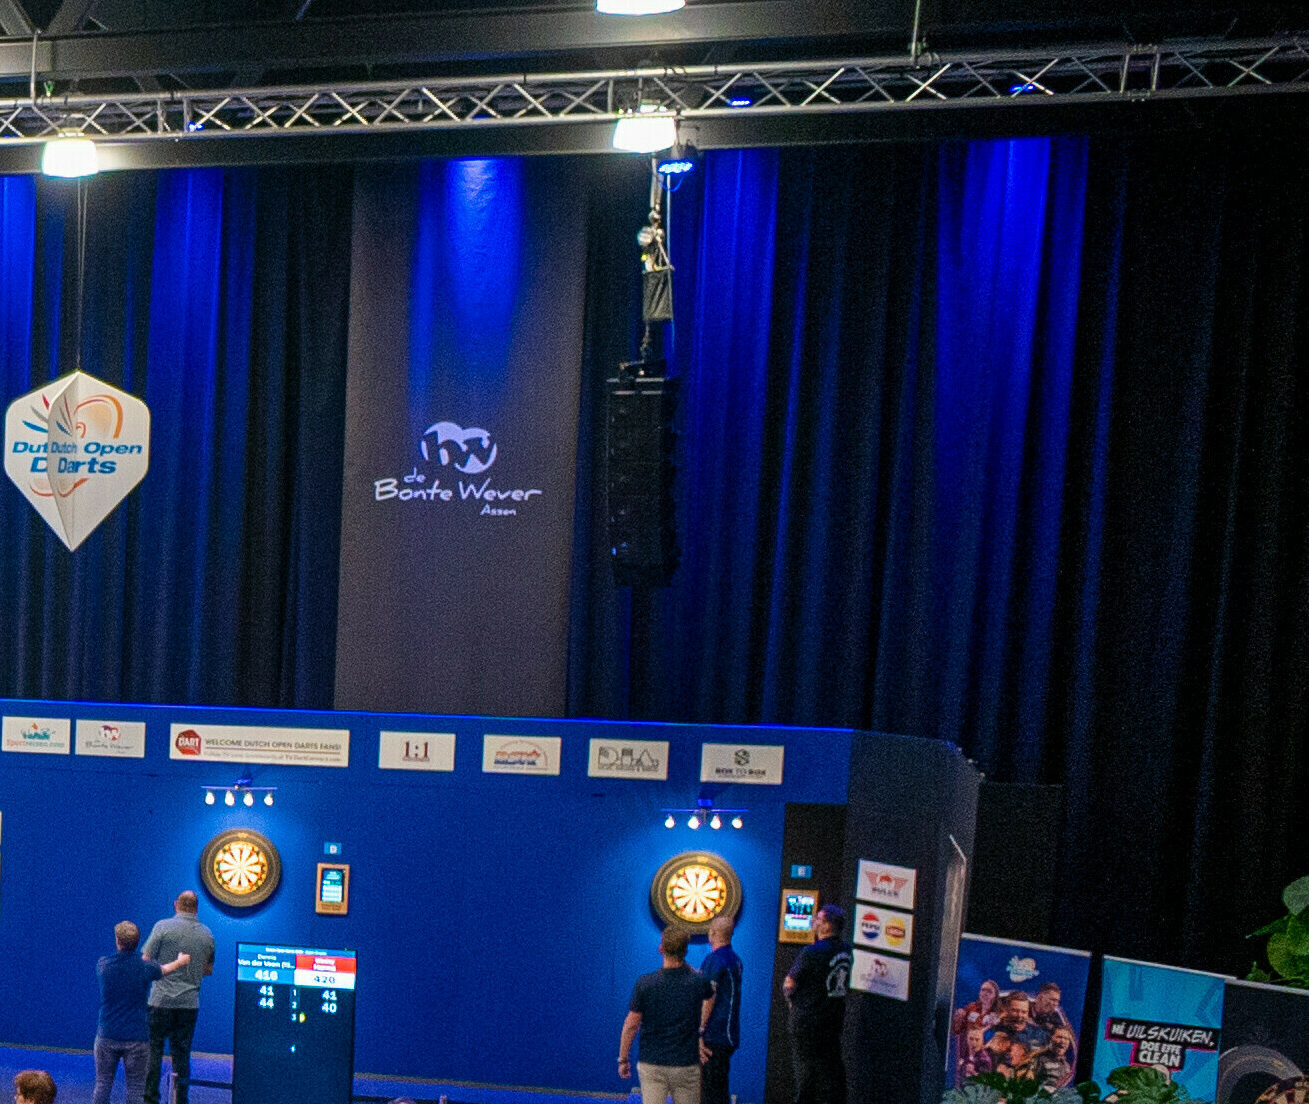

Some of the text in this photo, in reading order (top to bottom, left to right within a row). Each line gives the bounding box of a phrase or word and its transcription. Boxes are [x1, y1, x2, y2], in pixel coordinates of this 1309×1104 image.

[12, 441, 48, 454] Dut
[51, 442, 143, 456] Dutch Open
[58, 457, 117, 474] Darts
[403, 467, 426, 483] de
[374, 478, 543, 501] Bonte Wever
[480, 504, 517, 516] Assen
[205, 739, 242, 747] WELCOME
[244, 740, 270, 748] DUTCH
[258, 984, 274, 997] 41
[321, 990, 337, 1001] 41
[258, 998, 274, 1009] 44
[321, 1002, 337, 1013] 40
[1140, 1040, 1160, 1051] DOE
[1138, 1050, 1181, 1067] CLEAN
